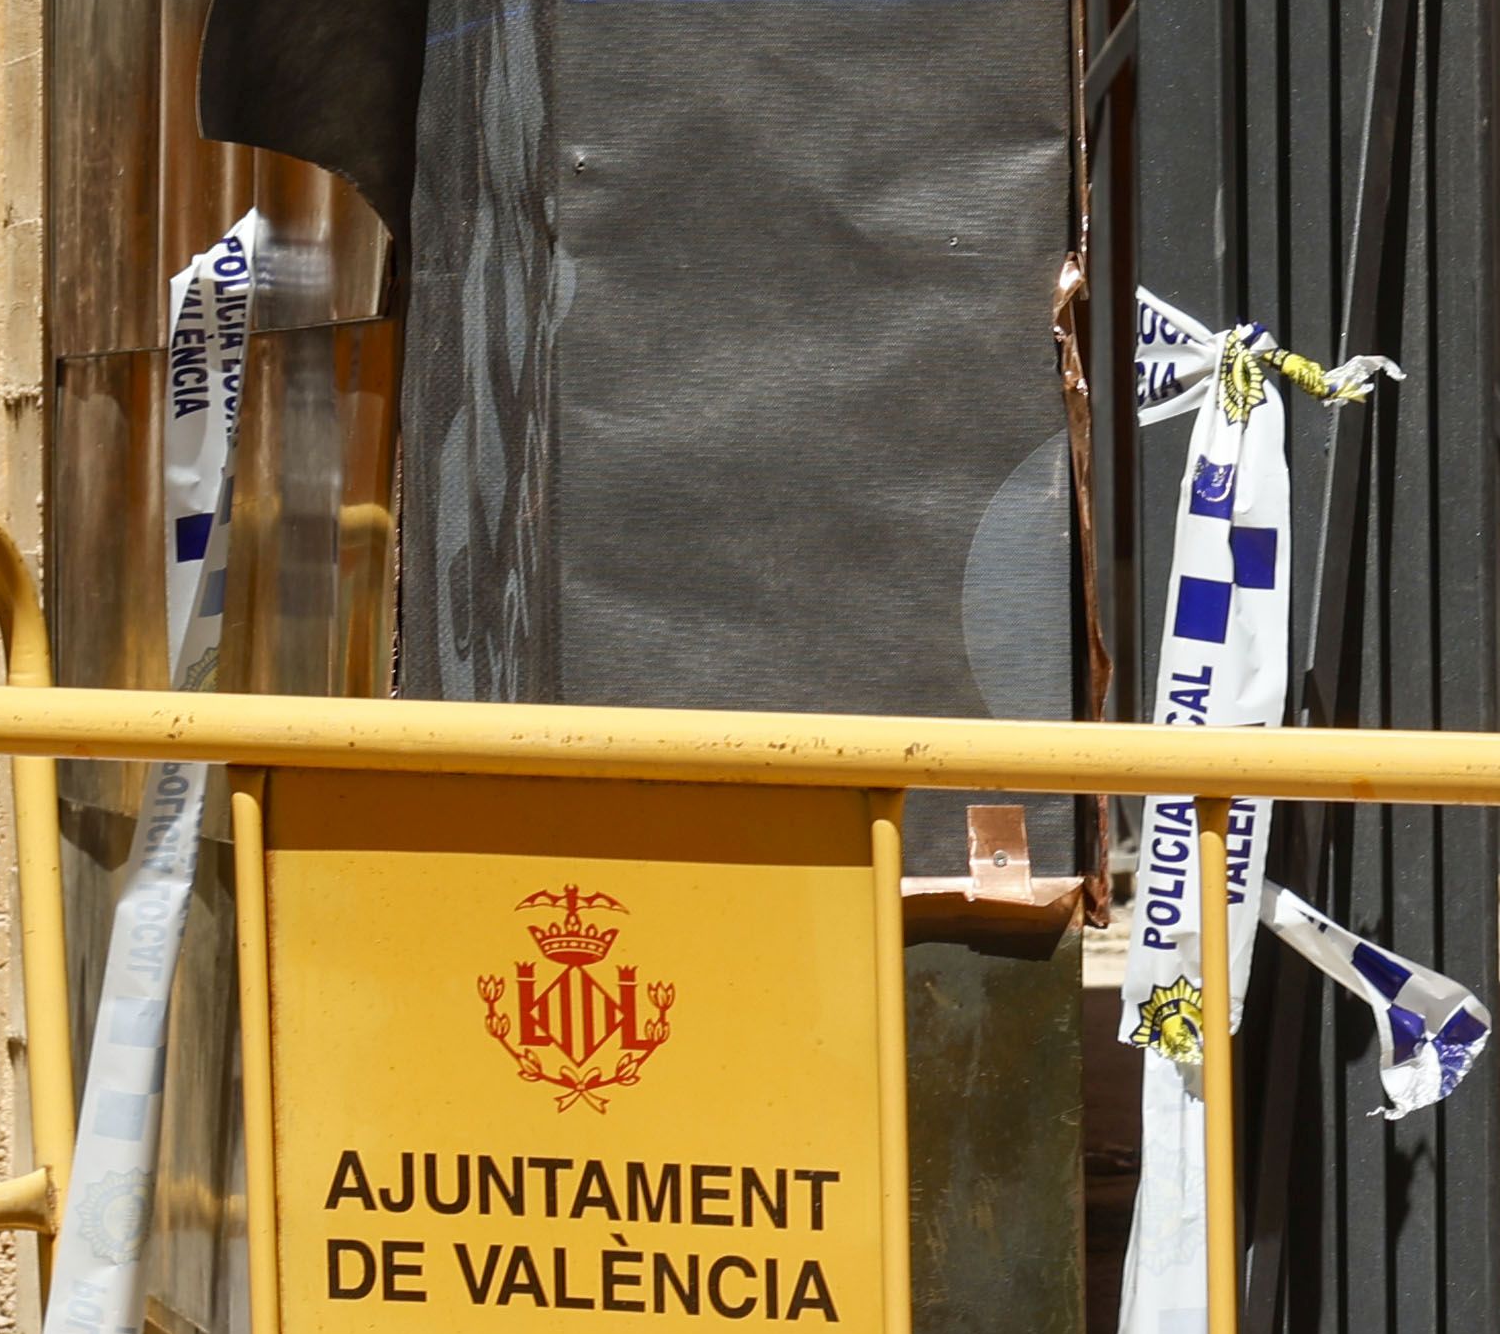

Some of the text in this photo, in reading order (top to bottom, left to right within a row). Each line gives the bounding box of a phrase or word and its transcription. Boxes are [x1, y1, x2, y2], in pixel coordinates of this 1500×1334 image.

[1143, 796, 1196, 951] POLICIA
[324, 1149, 841, 1231] AJUNTAMENT
[327, 1232, 841, 1323] DE VALÈNCIA
